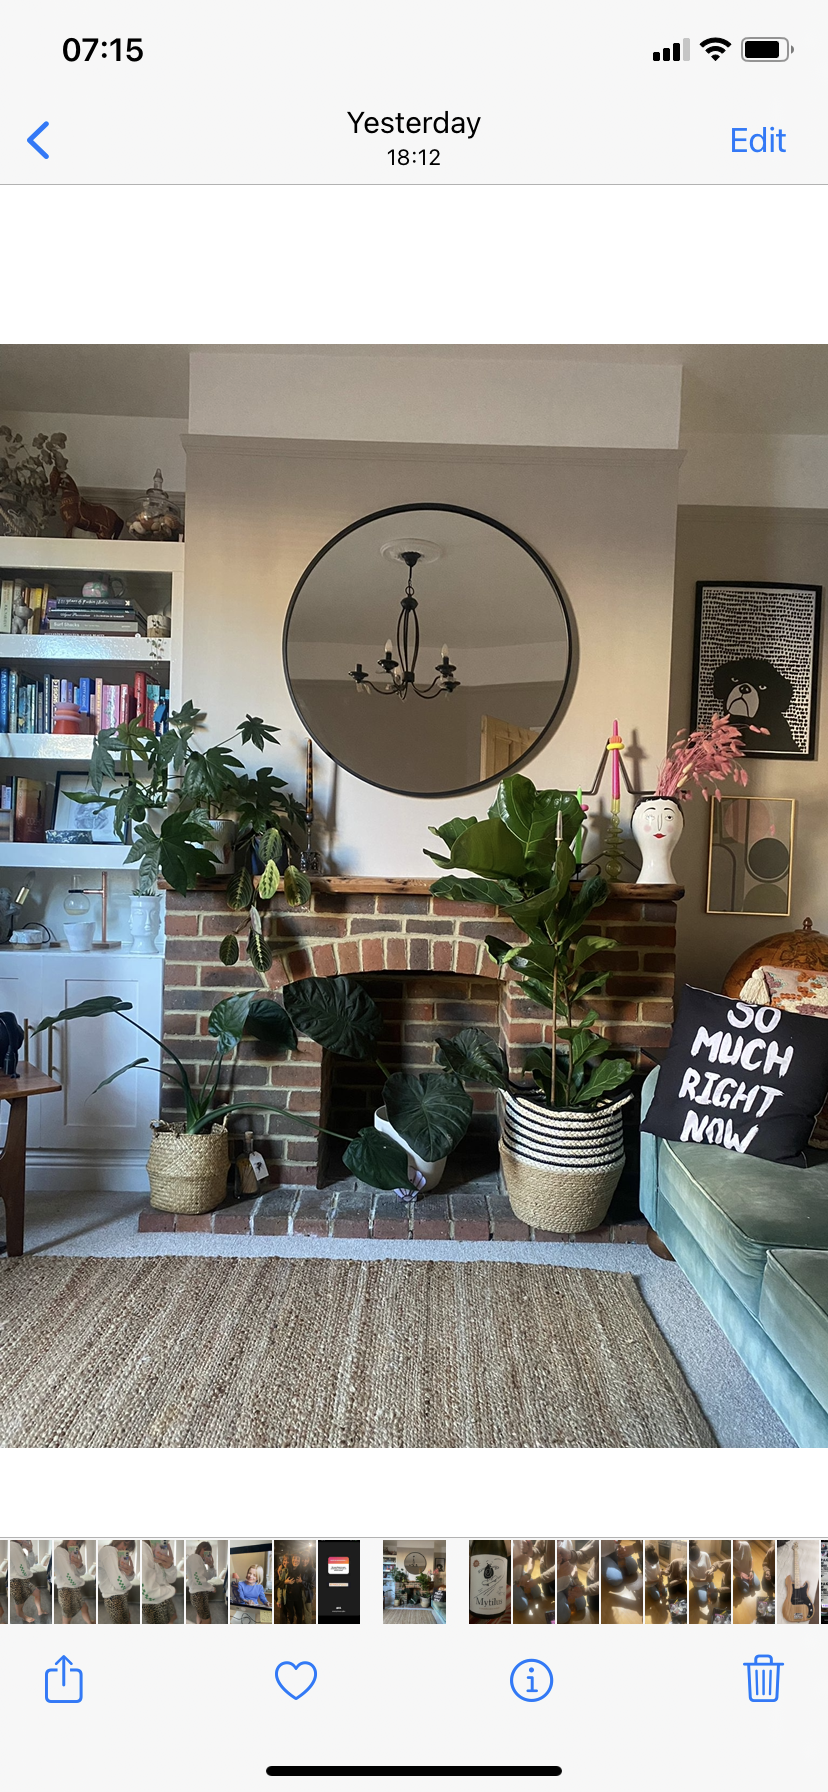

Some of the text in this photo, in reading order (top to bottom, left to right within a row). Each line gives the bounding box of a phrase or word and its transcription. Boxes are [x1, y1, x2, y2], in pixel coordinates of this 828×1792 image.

[63, 38, 143, 62] 07:15
[347, 111, 481, 139] Yesterday
[732, 127, 786, 152] Edit
[388, 149, 440, 165] 18:12
[727, 1001, 781, 1033] SO
[690, 1025, 794, 1078] MUCH
[678, 1067, 785, 1118] RIGHT
[680, 1109, 760, 1154] NOW
[475, 1598, 502, 1607] Mytilus
